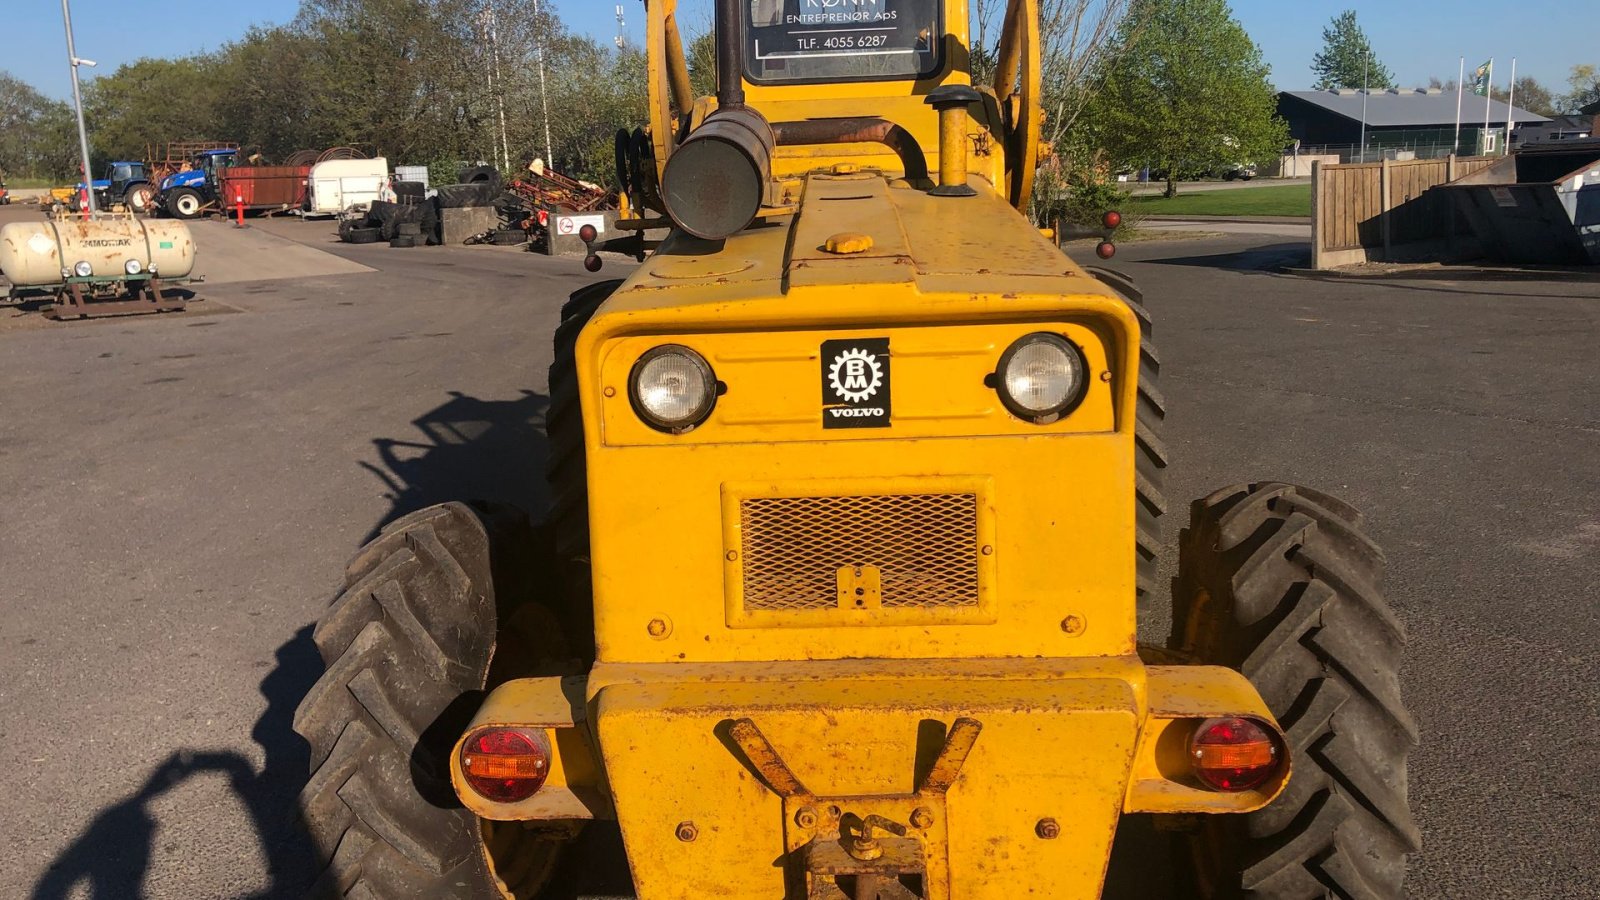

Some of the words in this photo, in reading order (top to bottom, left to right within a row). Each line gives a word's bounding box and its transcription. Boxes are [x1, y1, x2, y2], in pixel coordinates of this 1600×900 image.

[787, 12, 869, 23] ENTREPRENØR
[874, 10, 897, 21] ApS
[797, 38, 820, 50] TLF.
[823, 36, 854, 49] 4055
[857, 35, 887, 48] 6287
[829, 408, 885, 418] VOLVO
